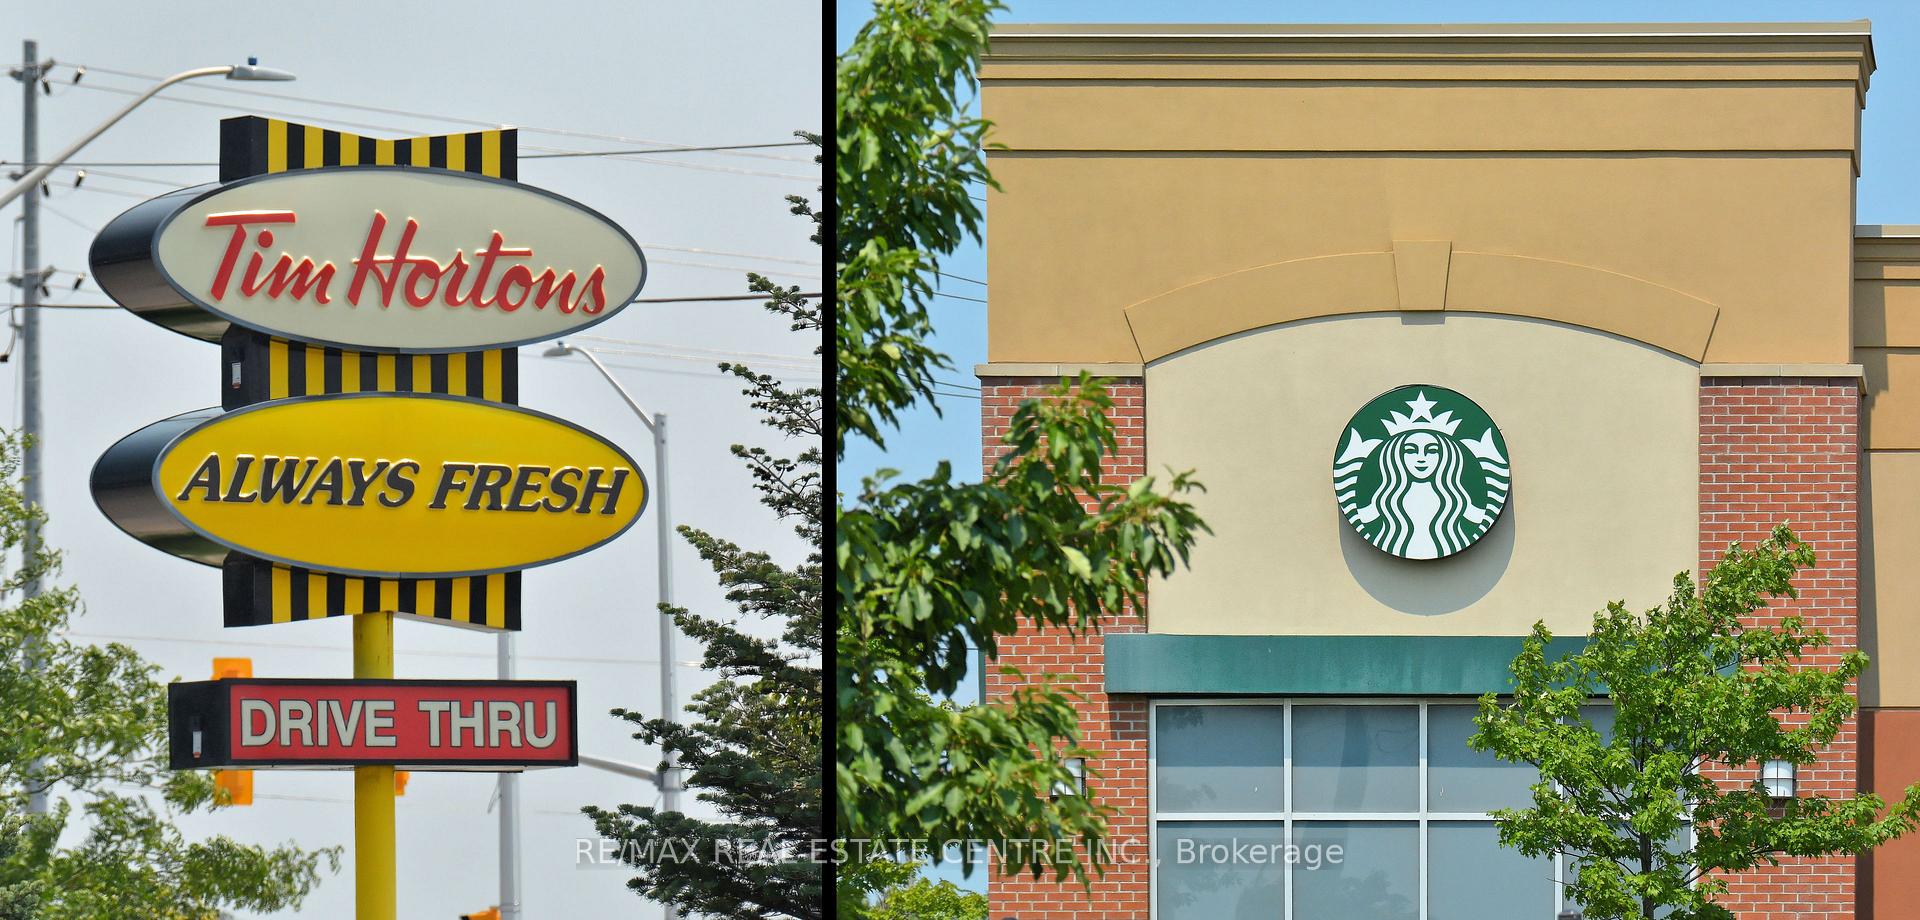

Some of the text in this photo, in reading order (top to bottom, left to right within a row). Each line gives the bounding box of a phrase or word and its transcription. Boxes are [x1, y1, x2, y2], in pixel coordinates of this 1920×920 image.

[205, 210, 606, 315] Tim Hortons
[177, 453, 629, 515] ALWAYS FRESH
[240, 698, 559, 749] DRIVE THRU
